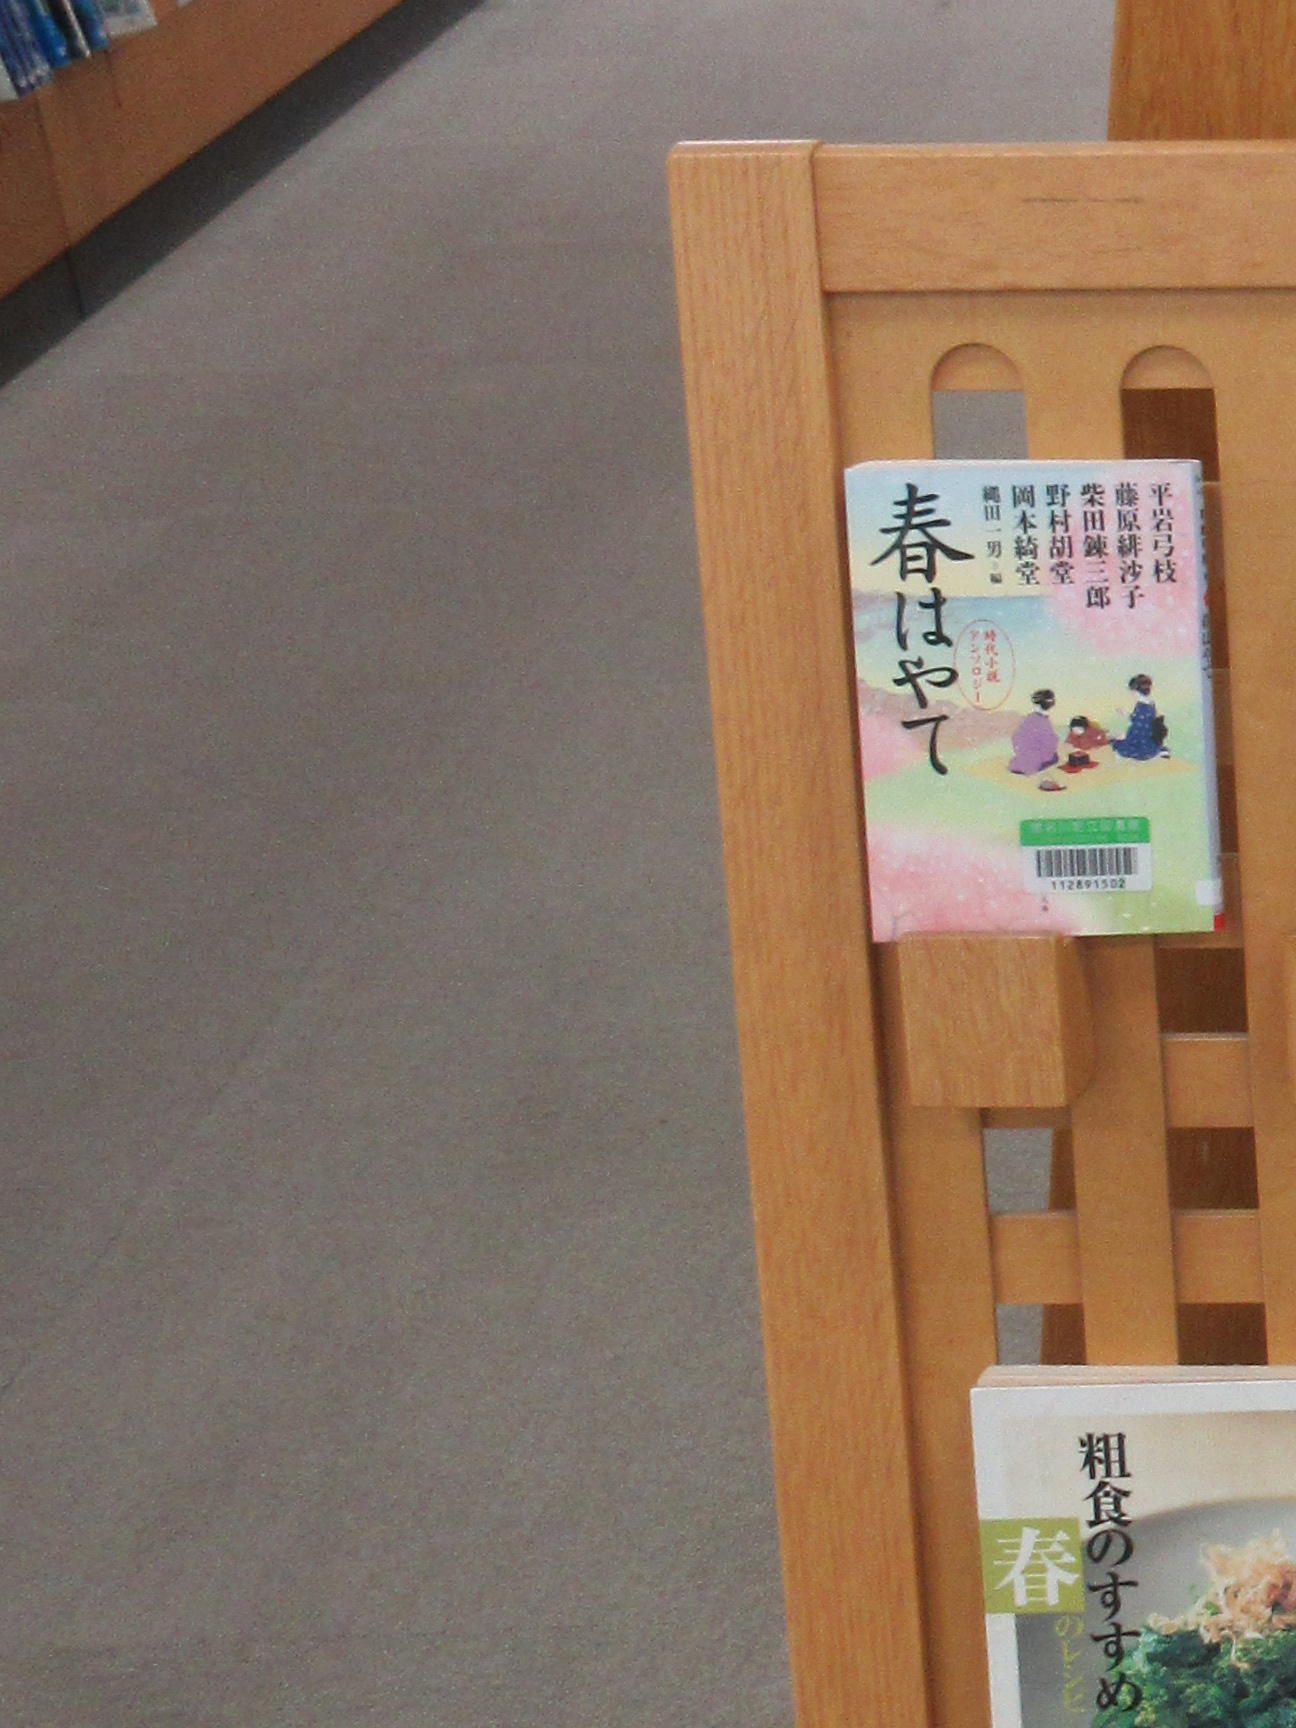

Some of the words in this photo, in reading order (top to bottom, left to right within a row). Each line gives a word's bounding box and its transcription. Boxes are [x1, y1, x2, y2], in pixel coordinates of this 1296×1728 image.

[1012, 484, 1041, 586] 岡本綺堂
[1045, 483, 1075, 585] 野村胡堂
[1115, 482, 1145, 610] 藤原緋沙子
[1150, 482, 1177, 584] 平岩弓枝
[869, 482, 975, 776] 春はやて
[984, 629, 1000, 683] 時代小説
[993, 1526, 1081, 1607] 春
[1079, 1431, 1142, 1713] 粗食のすすめ
[1053, 1614, 1088, 1714] のレシピ
